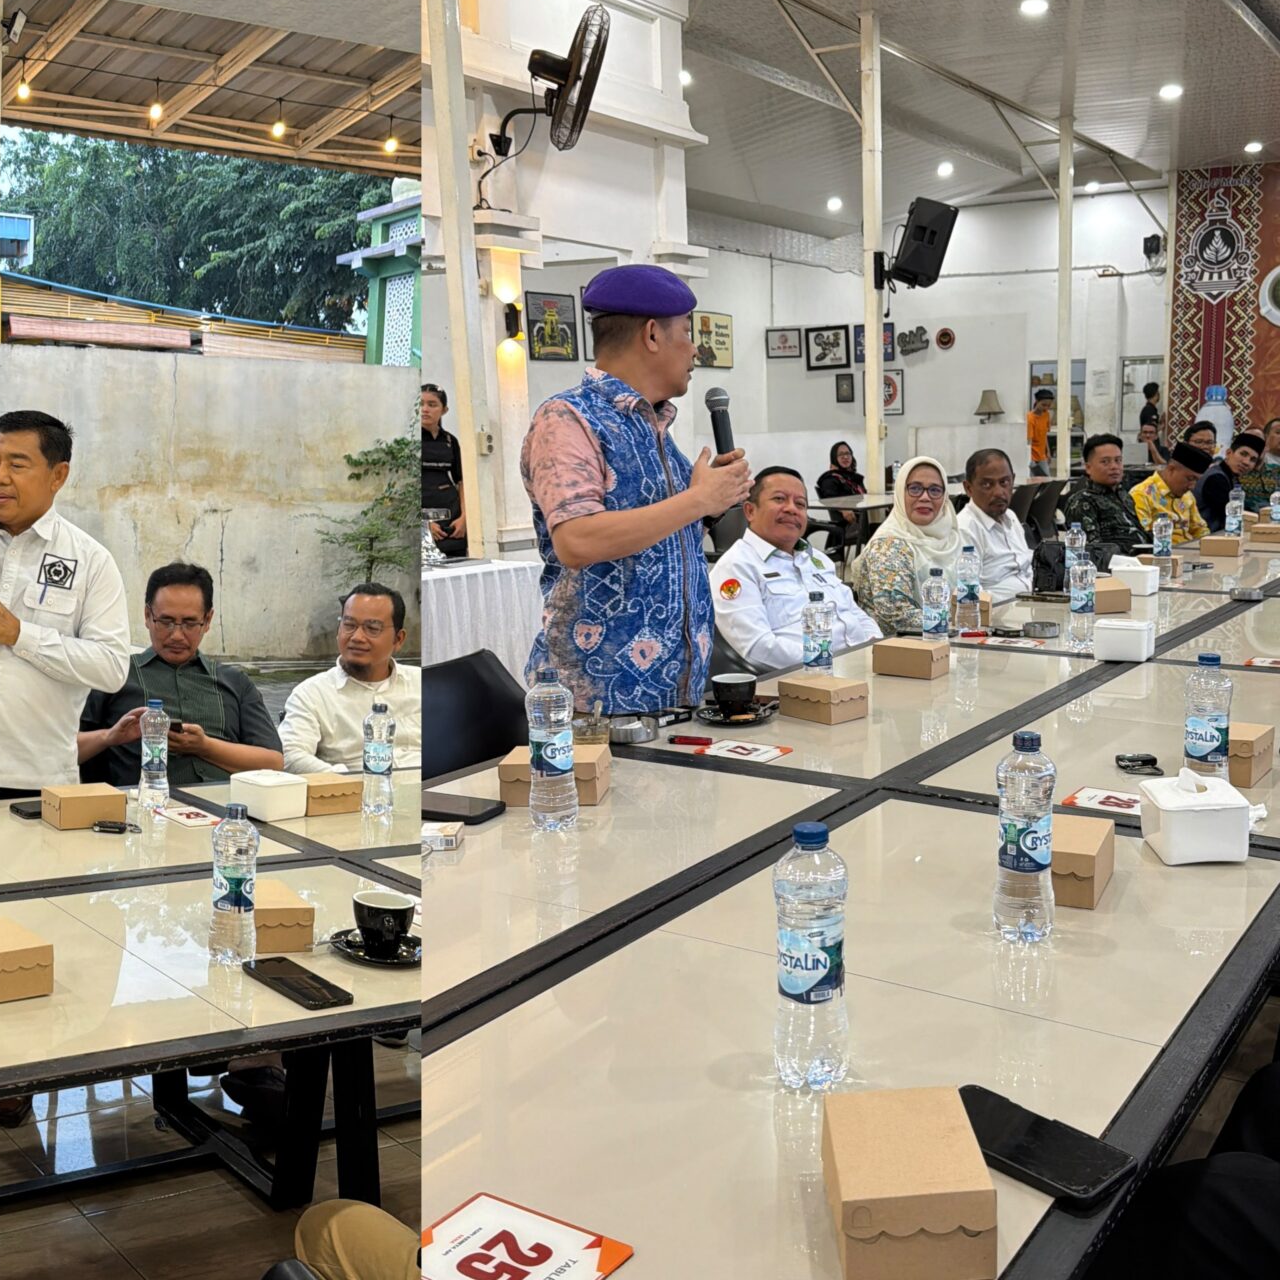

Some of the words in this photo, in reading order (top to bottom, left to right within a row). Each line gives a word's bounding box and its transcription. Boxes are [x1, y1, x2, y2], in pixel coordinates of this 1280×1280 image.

[1186, 272, 1196, 281] 20
[1097, 794, 1141, 809] 28
[456, 1229, 554, 1280] 25
